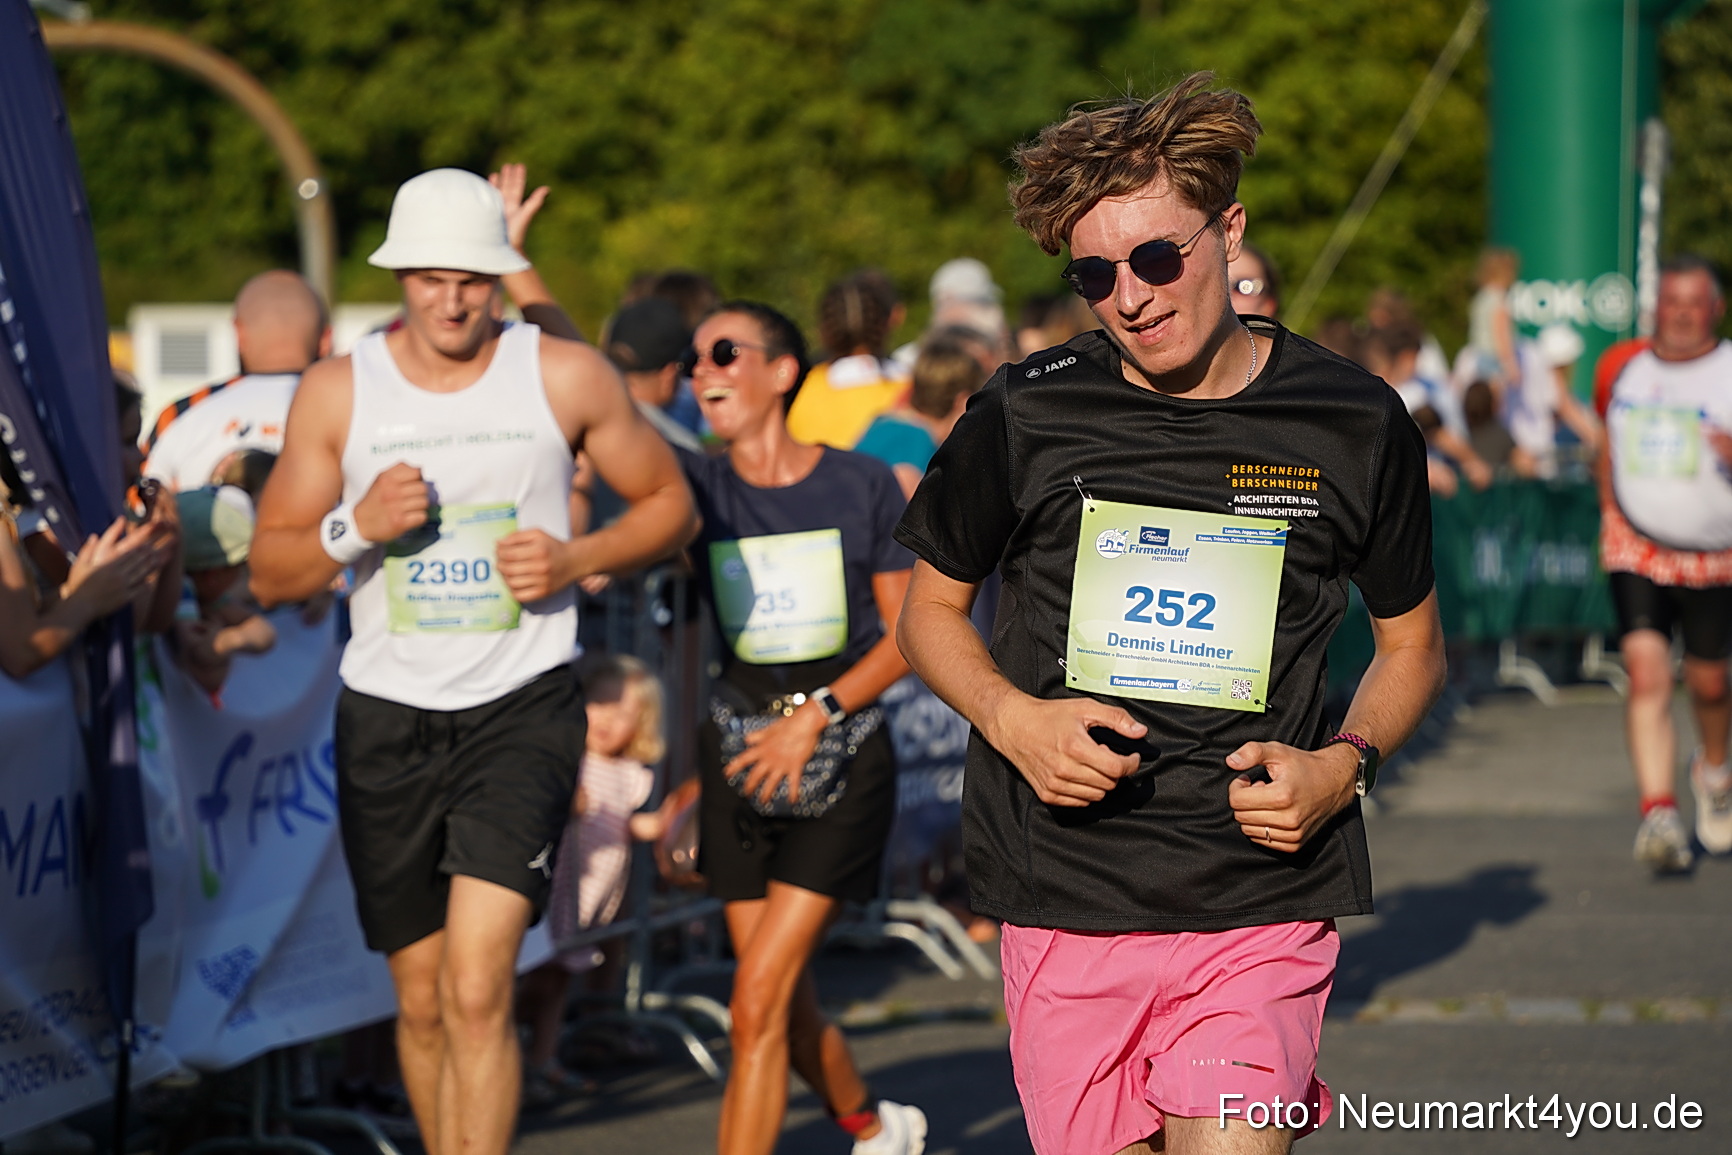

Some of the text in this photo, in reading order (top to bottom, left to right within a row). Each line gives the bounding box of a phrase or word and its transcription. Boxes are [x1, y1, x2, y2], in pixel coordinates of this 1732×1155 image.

[1045, 356, 1077, 373] JAKO
[1231, 464, 1320, 478] BERSCHNEIDER
[1231, 478, 1318, 491] BERSCHNEIDER
[1233, 494, 1320, 506] ARCHITEKTEN BDA
[1234, 506, 1320, 518] INNENARCHITEKTEN
[1128, 543, 1190, 557] Firmenlauf
[1151, 555, 1188, 563] neumarkt
[408, 559, 491, 584] 2390
[1124, 585, 1216, 631] 252
[1107, 632, 1234, 660] Dennis Lindner
[1076, 647, 1111, 656] Berschneider
[1115, 652, 1150, 661] Berschneider
[1167, 658, 1199, 667] Architekten
[1215, 664, 1261, 674] Innenarchitekten
[1113, 678, 1175, 689] firmenlauf.bayern
